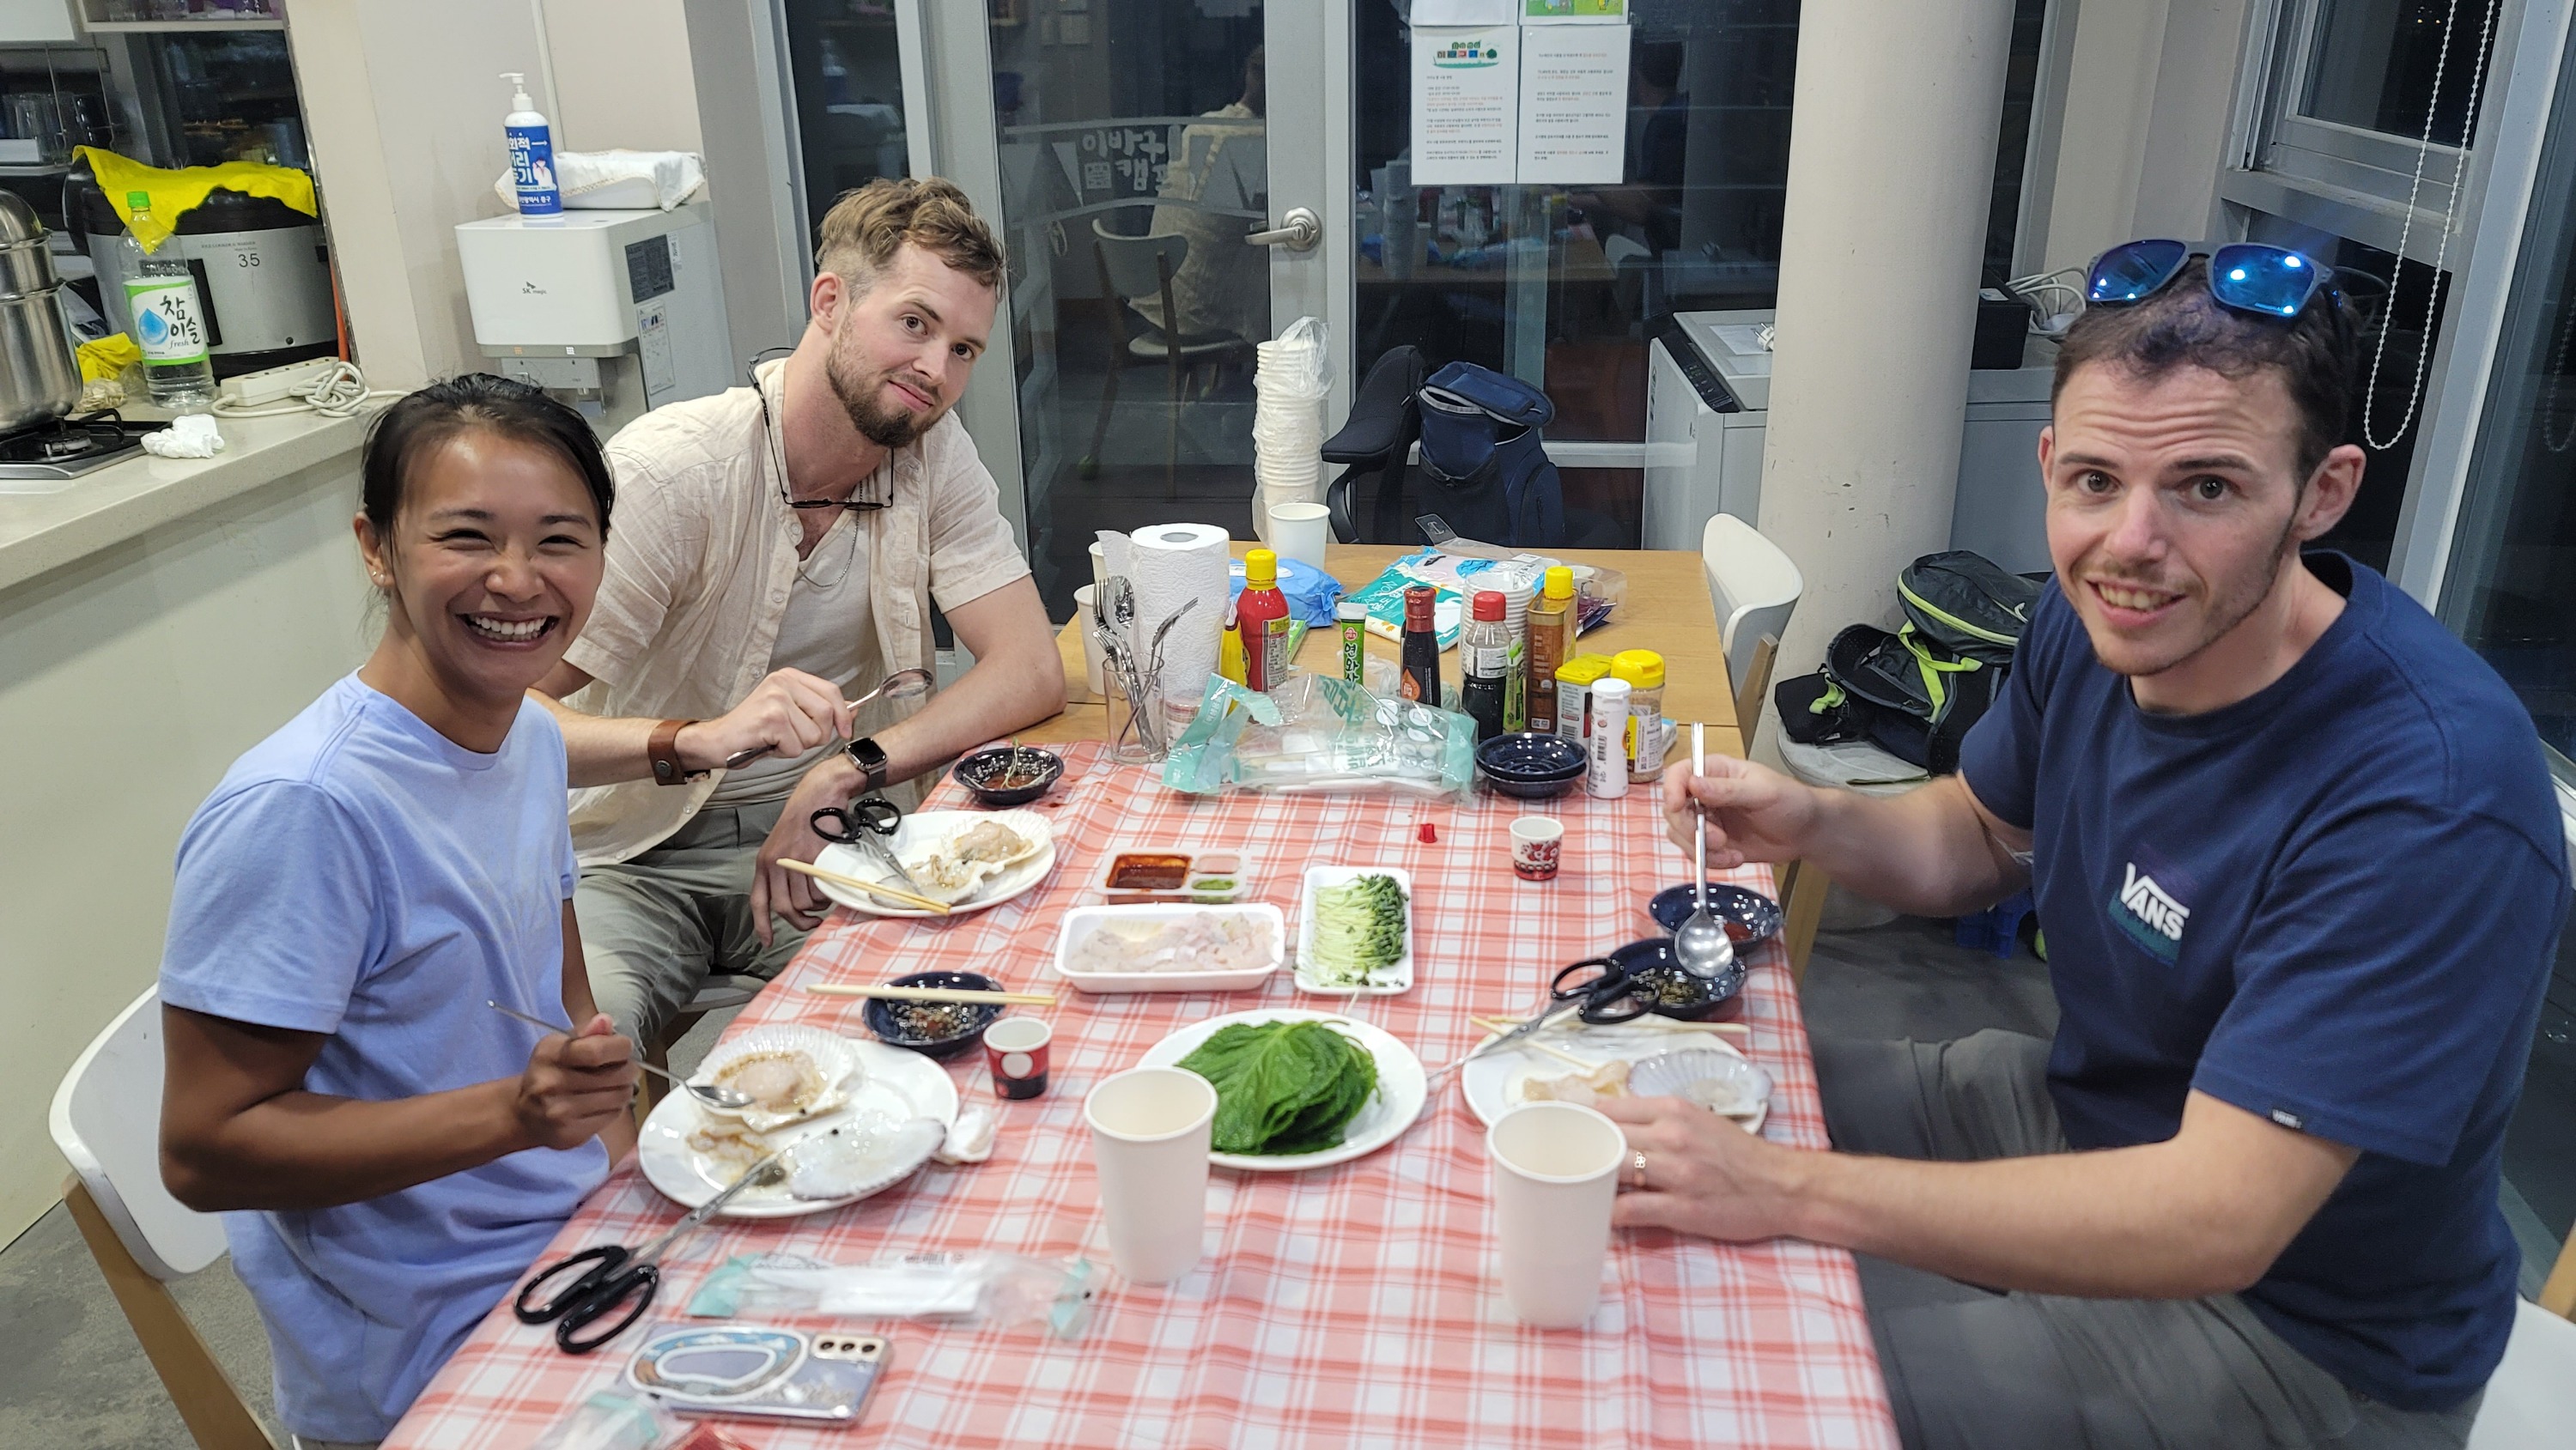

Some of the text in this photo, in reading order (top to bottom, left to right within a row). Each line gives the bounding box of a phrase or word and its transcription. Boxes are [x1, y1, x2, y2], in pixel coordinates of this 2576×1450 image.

[508, 137, 532, 150] 회적
[1082, 129, 1166, 164] 이바구
[238, 253, 260, 268] 35
[160, 295, 185, 320] 참
[170, 317, 200, 344] 이슬
[168, 338, 190, 349] fresh
[2121, 862, 2190, 941] VANS
